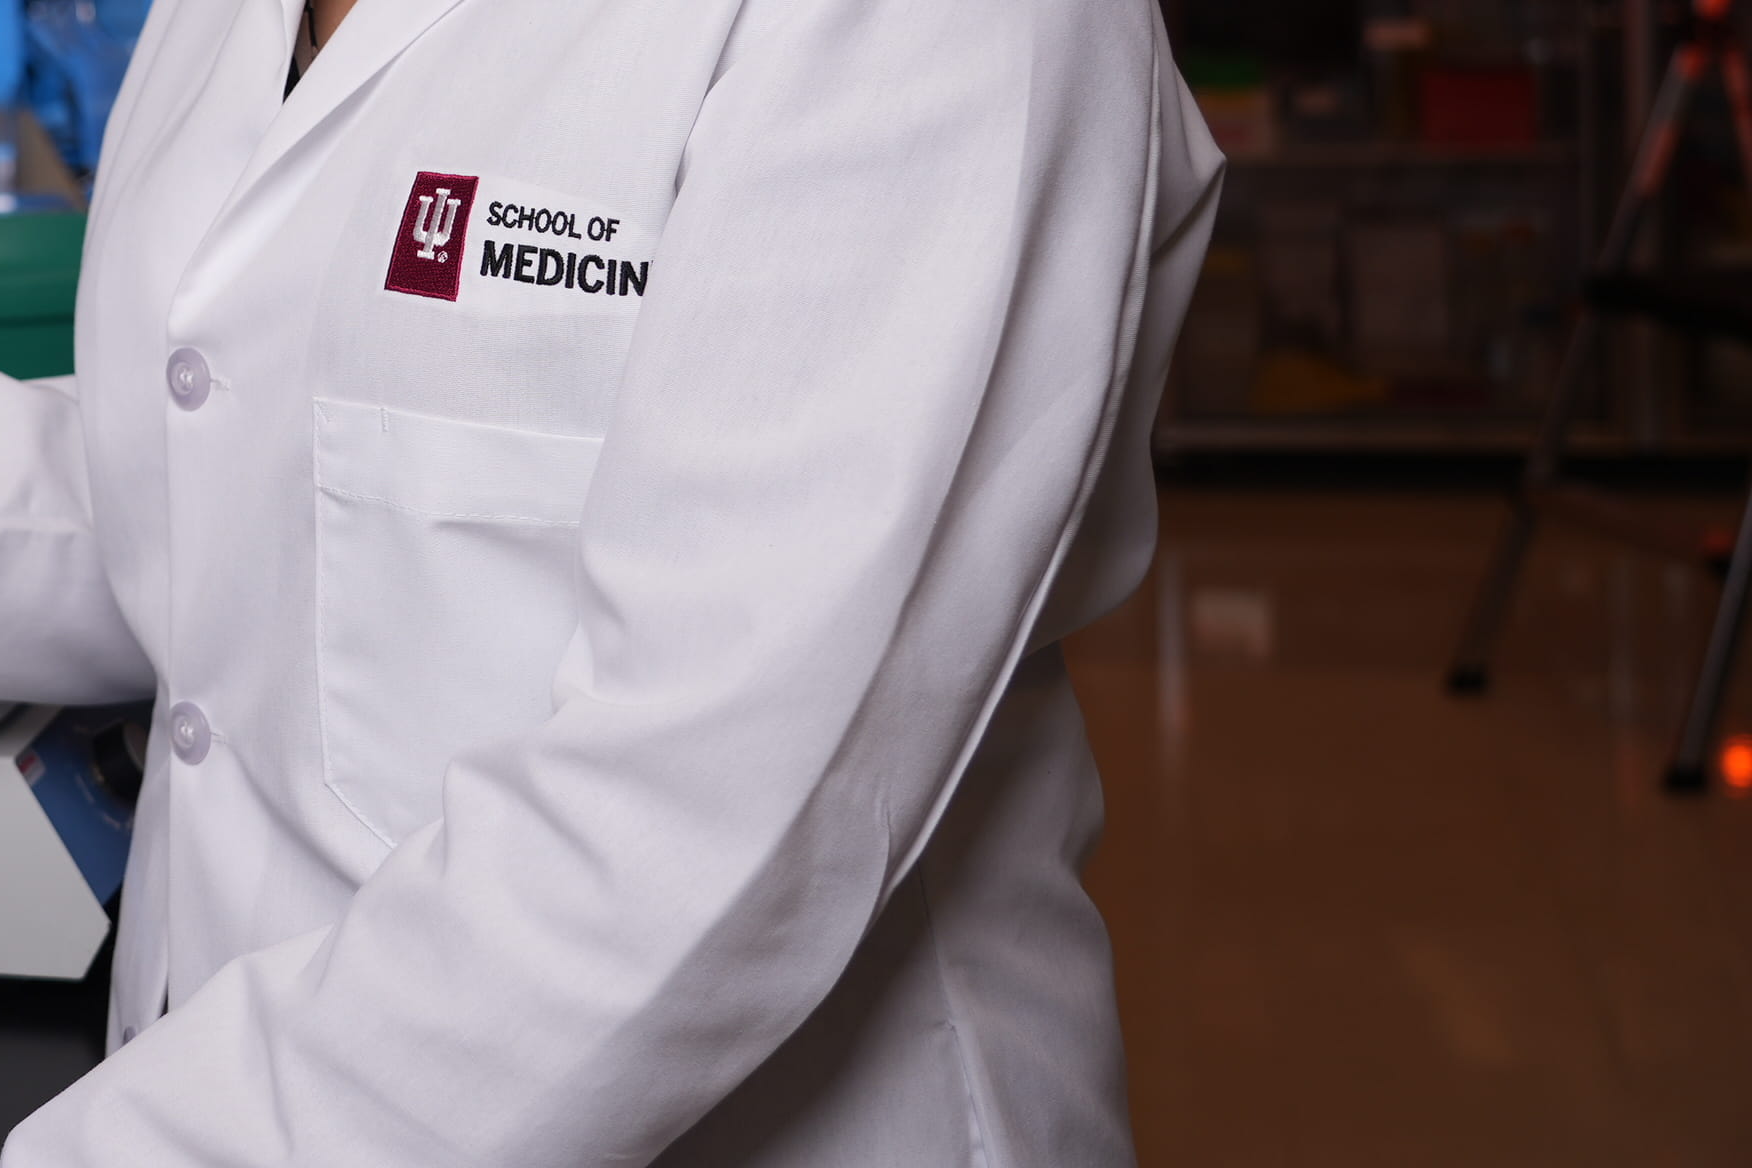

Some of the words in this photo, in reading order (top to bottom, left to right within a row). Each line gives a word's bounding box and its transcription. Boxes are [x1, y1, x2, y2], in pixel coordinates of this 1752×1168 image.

[486, 200, 582, 240] SCHOOL
[587, 216, 620, 242] OF
[480, 239, 650, 297] MEDICIN
